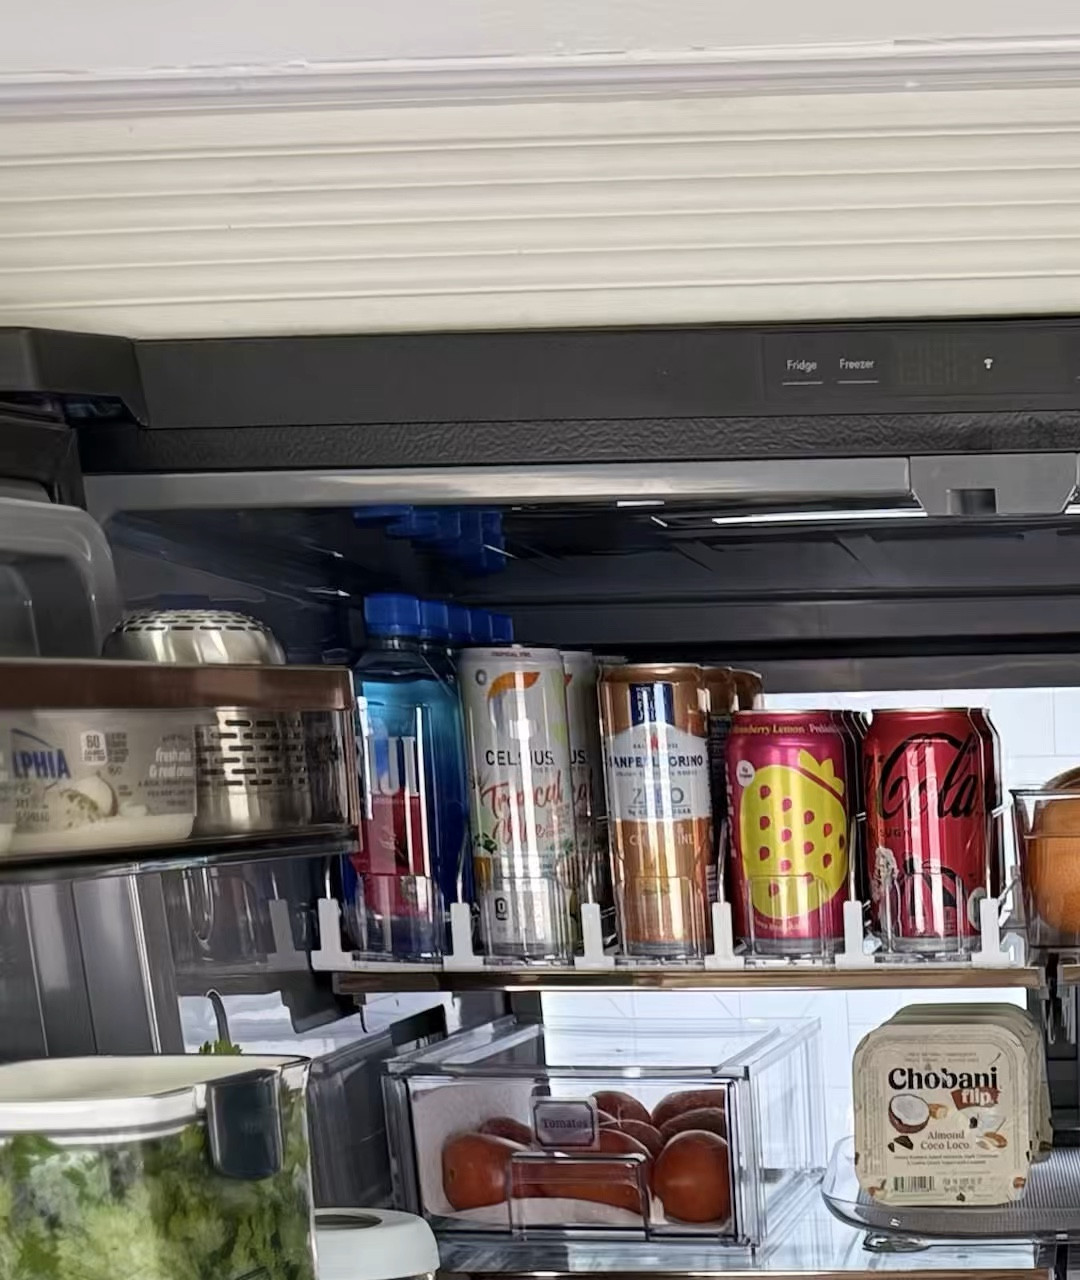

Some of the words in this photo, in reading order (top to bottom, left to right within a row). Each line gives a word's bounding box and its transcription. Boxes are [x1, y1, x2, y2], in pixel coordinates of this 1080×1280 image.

[786, 359, 818, 373] Fridge
[839, 358, 875, 369] Freezer
[773, 724, 806, 734] Lemon
[888, 1066, 999, 1091] Chobani
[927, 1131, 965, 1140] Almond
[920, 1141, 945, 1151] Coco
[946, 1141, 970, 1151] Loco
